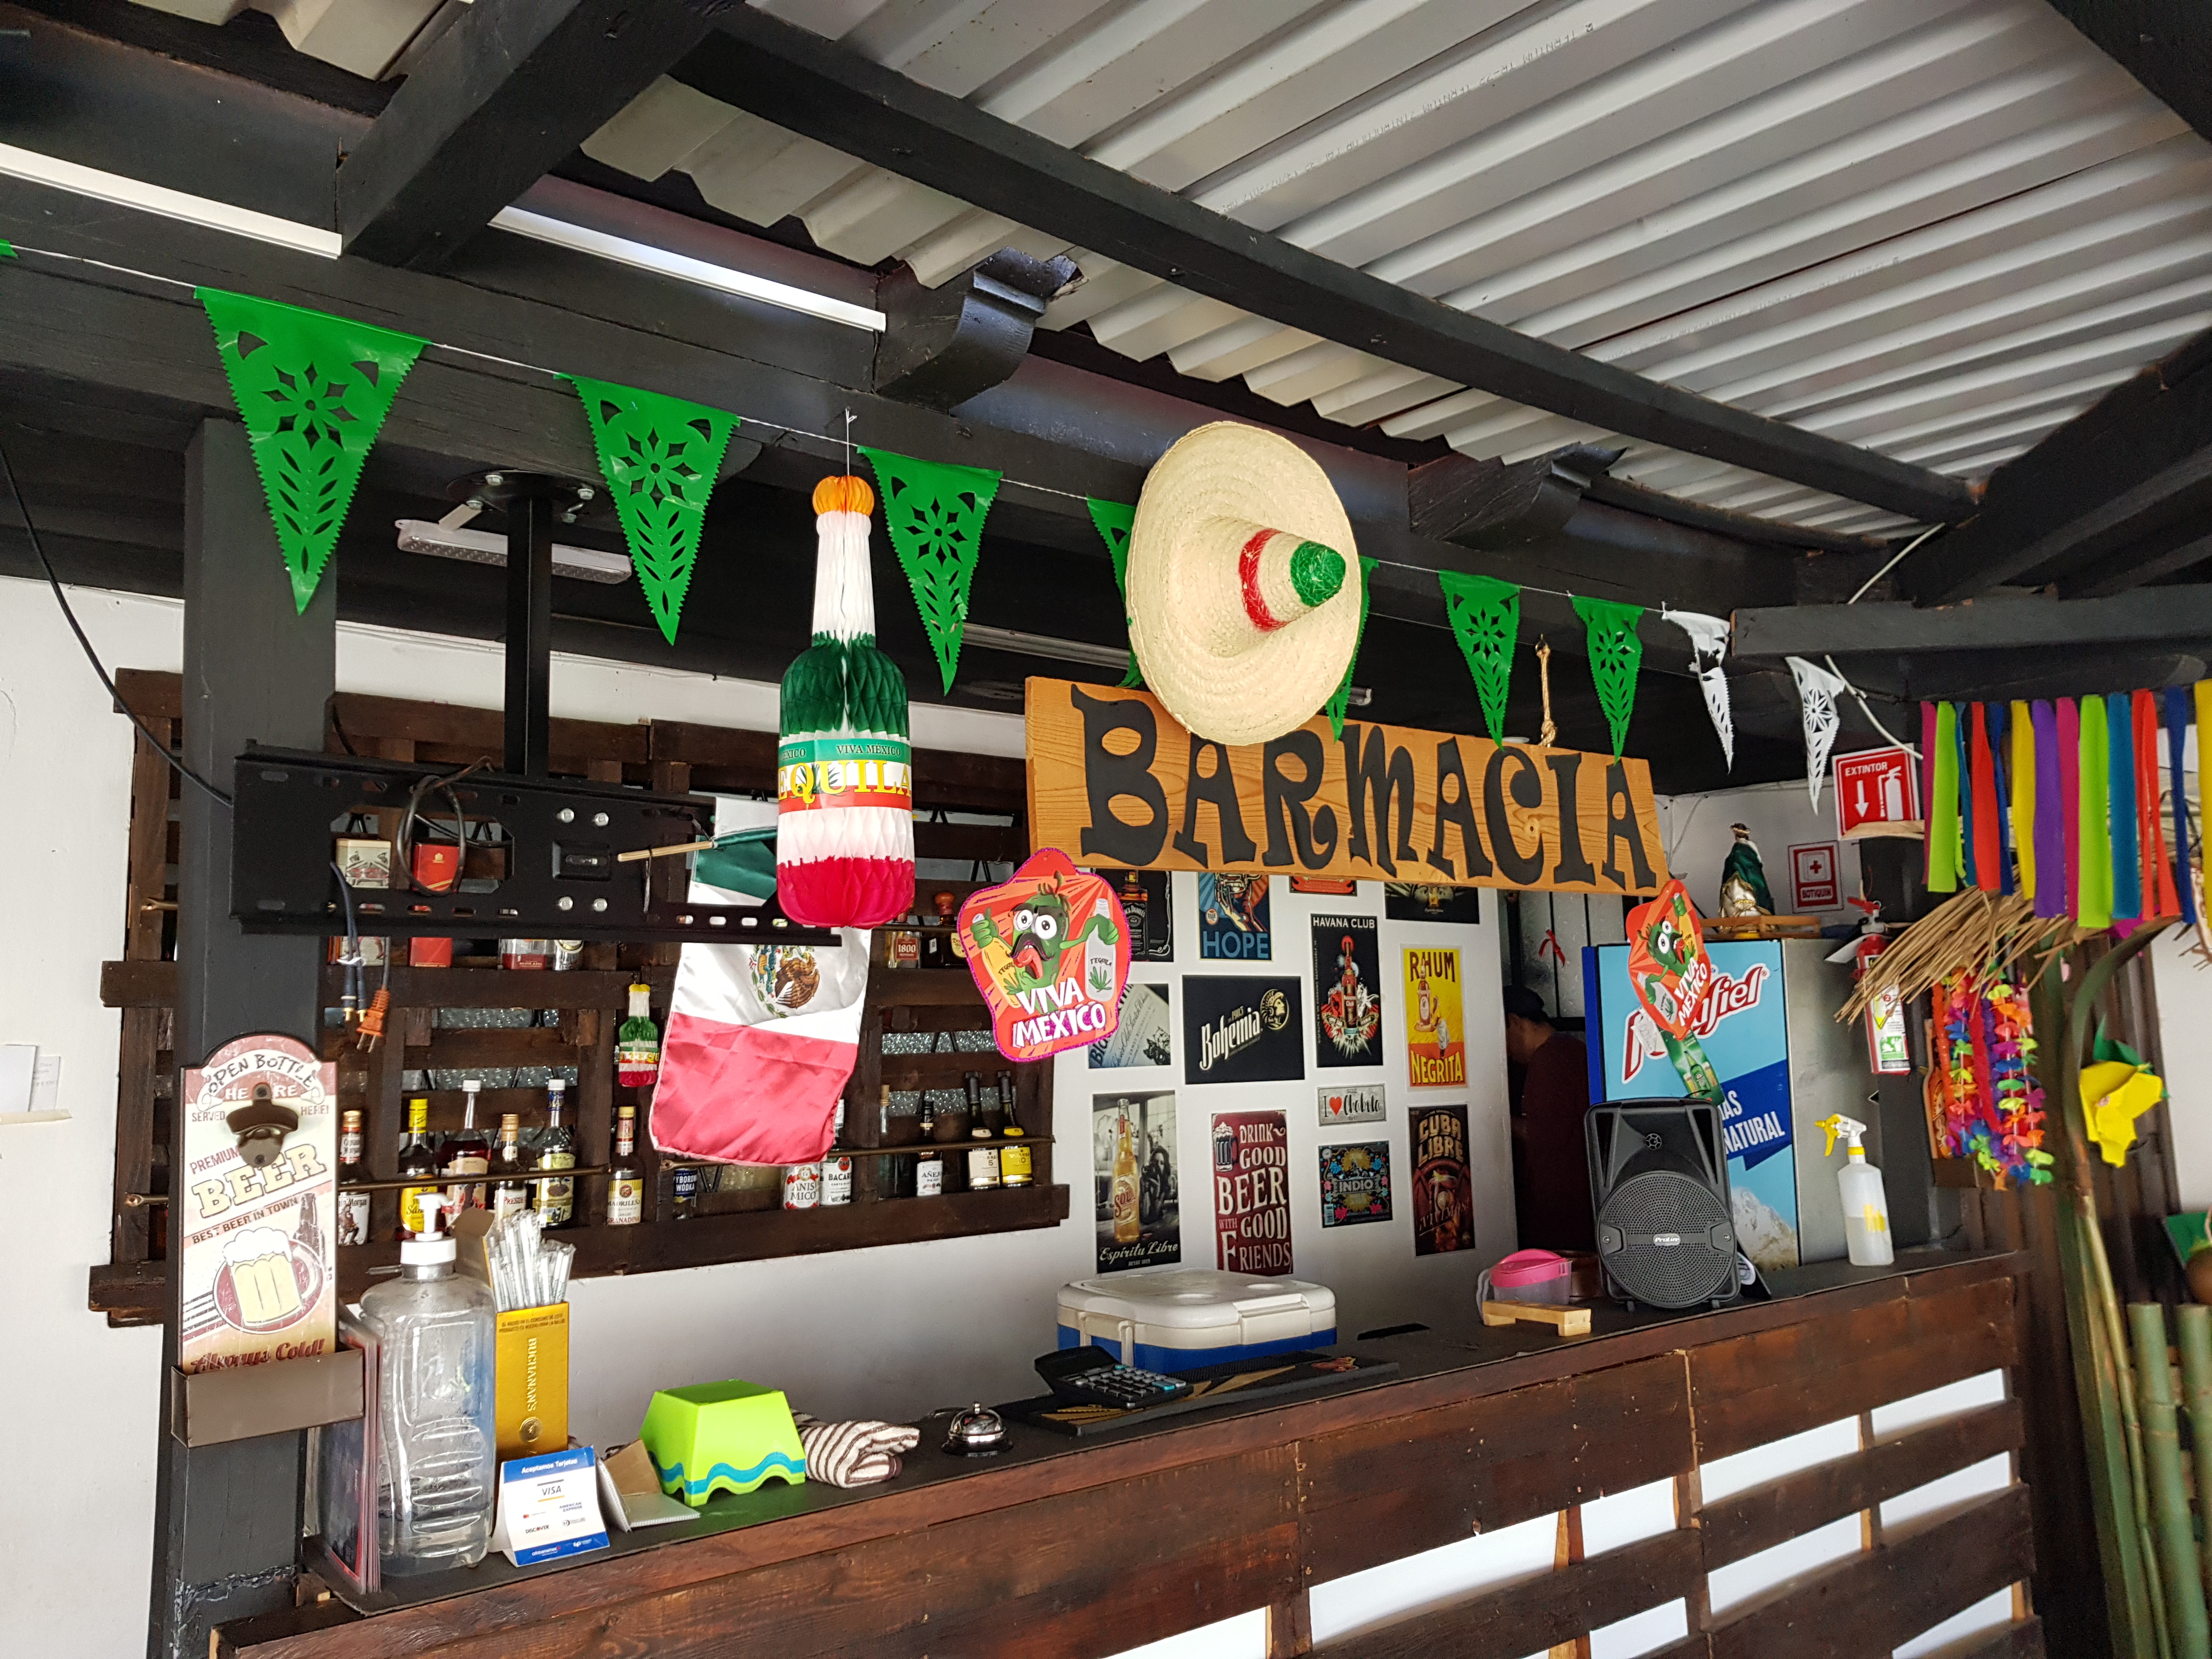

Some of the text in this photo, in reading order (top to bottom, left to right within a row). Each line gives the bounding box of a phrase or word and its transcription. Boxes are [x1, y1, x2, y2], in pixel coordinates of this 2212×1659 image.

[836, 743, 901, 757] VIVA MÉXICO
[778, 759, 911, 805] EQUILA
[1845, 761, 1888, 776] EXTINTOR
[1071, 684, 1657, 888] BARMACIA
[1313, 917, 1375, 929] HAVANA CLUB
[898, 944, 916, 953] 1800
[1203, 931, 1269, 959] HOPE
[998, 961, 1015, 975] TEQUIL
[1090, 957, 1113, 966] TEQUILA
[1409, 951, 1455, 982] RHUM
[1674, 957, 1700, 998] VIVA
[1016, 977, 1085, 1015] VIVA
[1678, 963, 1708, 1027] MEXICO
[1013, 1002, 1106, 1048] MEXICO
[1199, 1007, 1261, 1071] Bohemia
[208, 1054, 316, 1093] OPEN BOTTLE
[1411, 1050, 1464, 1084] NEGRITA
[191, 1105, 329, 1122] SERVED HERE!
[1323, 1096, 1328, 1118] I
[1718, 1090, 1742, 1120] AS
[1239, 1123, 1274, 1144] DRINK
[1420, 1114, 1462, 1142] CUBA
[1723, 1111, 1785, 1154] NATURAL
[190, 1145, 240, 1175] PREMIUM
[1239, 1146, 1286, 1169] GOOD
[1418, 1136, 1464, 1168] LIBRE
[191, 1144, 327, 1218] BEER
[792, 1182, 815, 1191] ANIS
[828, 1172, 851, 1181] BACAR
[1216, 1166, 1287, 1215] BEER
[1339, 1180, 1373, 1193] INDIO
[790, 1191, 816, 1200] MICO
[193, 1197, 299, 1244] BEST BEER IN TOWN
[1218, 1218, 1238, 1229] WITH
[1240, 1207, 1288, 1239] GOOD
[1099, 1240, 1178, 1266] Espíritu Libre
[1220, 1231, 1293, 1274] FRIENDS
[276, 1338, 325, 1361] Cold!
[527, 1337, 537, 1413] BUCHANAN'S
[521, 1458, 578, 1474] Aceptamos Tarjetas
[542, 1486, 562, 1496] VISA
[526, 1525, 550, 1533] DISCOVER
